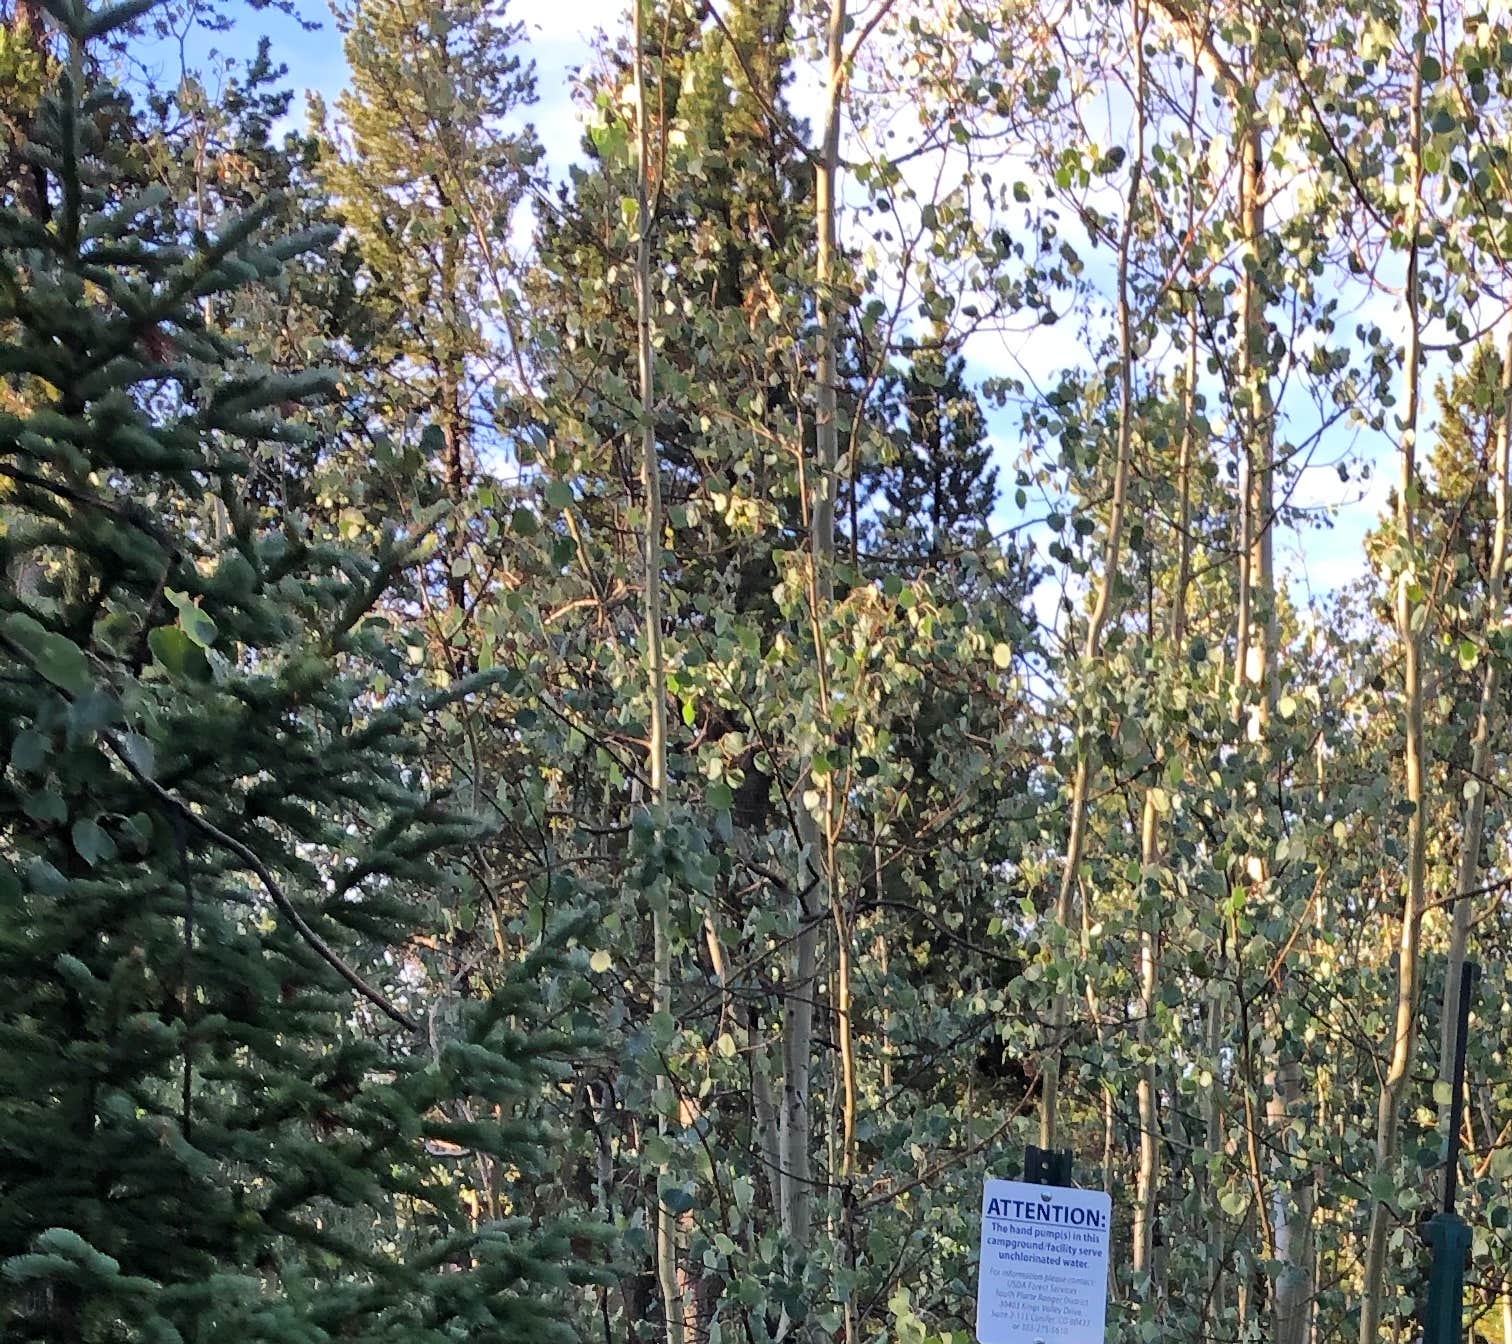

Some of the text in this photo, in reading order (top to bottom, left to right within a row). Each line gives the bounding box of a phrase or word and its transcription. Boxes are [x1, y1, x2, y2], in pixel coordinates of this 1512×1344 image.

[987, 1198, 1106, 1228] ATTENTION:
[992, 1222, 1100, 1243] The hand pump(s) in this
[987, 1237, 1103, 1257] campground/facility serve
[998, 1251, 1061, 1265] unchlorinated
